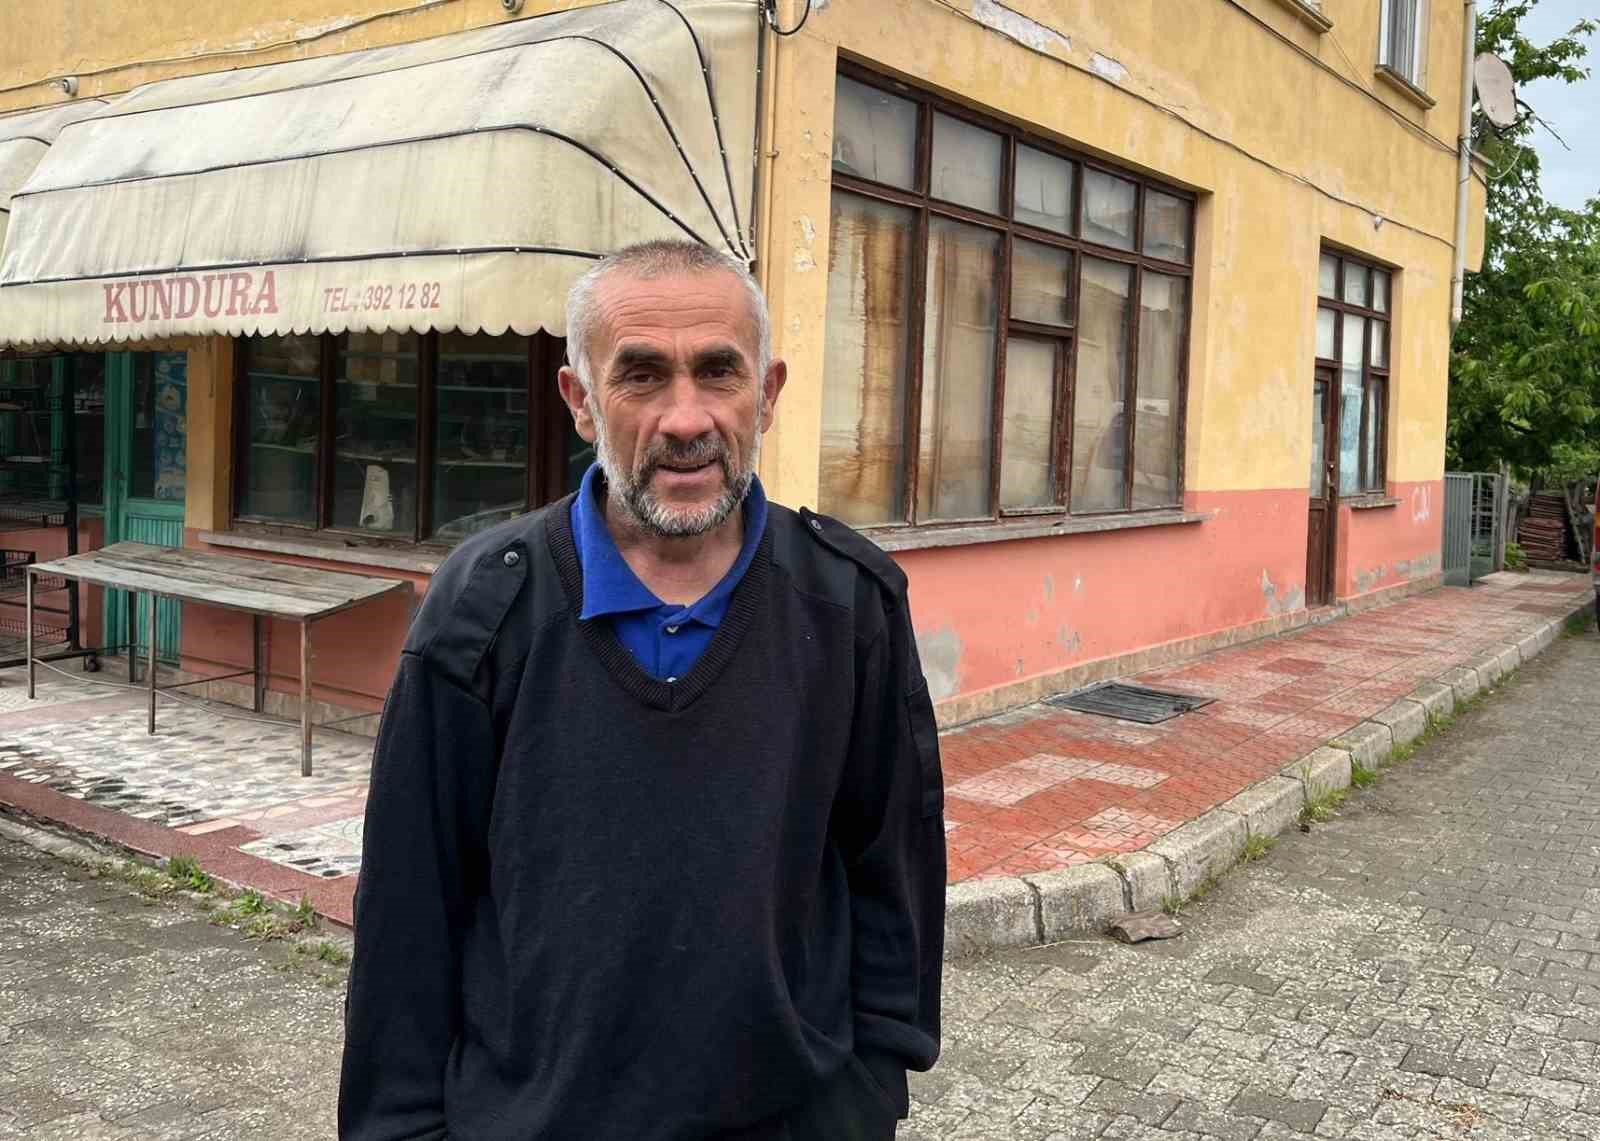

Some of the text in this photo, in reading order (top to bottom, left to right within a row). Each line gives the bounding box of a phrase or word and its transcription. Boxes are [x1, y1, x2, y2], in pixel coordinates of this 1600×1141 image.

[103, 271, 278, 323] KUNDURA
[365, 284, 393, 310] 392
[399, 282, 417, 309] 12
[420, 281, 440, 309] 82
